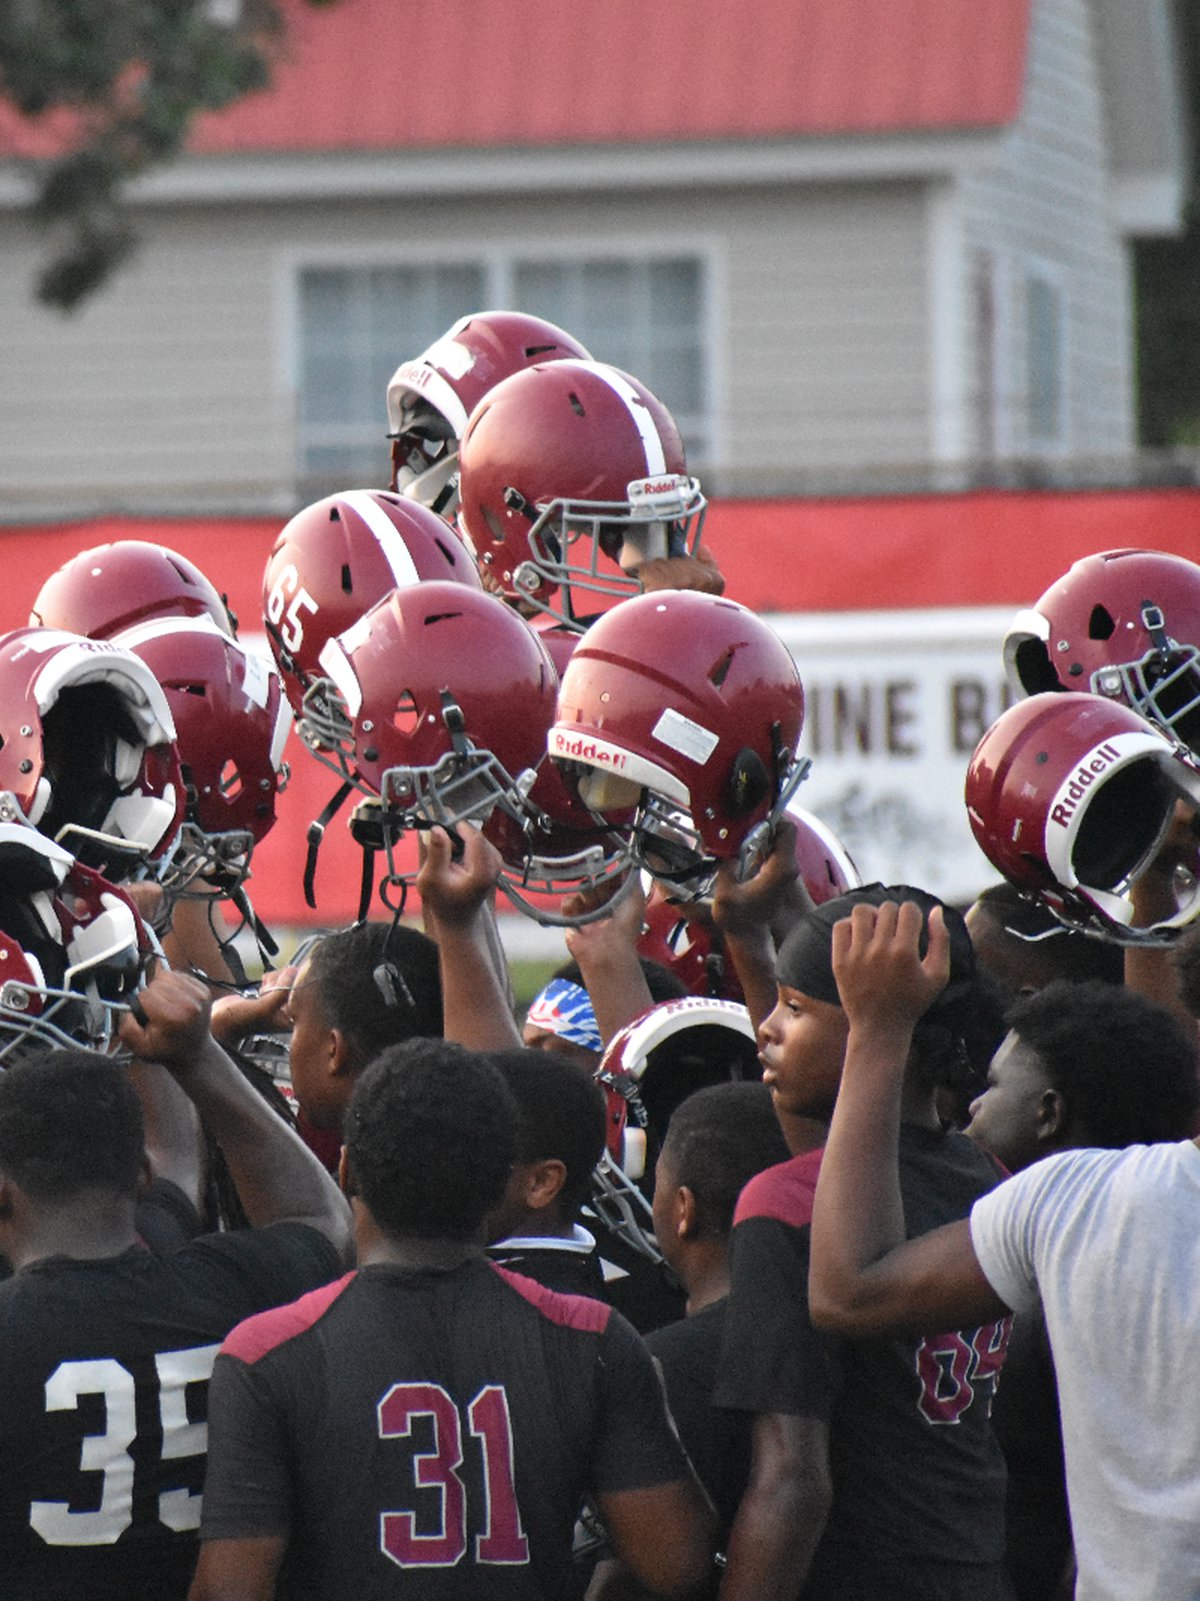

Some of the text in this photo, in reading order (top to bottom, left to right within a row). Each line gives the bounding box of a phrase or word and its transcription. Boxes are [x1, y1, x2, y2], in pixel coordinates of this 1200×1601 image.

[267, 563, 320, 653] 65
[556, 734, 629, 770] Riddell
[1050, 743, 1121, 830] Riddell
[28, 1342, 223, 1547] 35
[377, 1380, 531, 1569] 31
